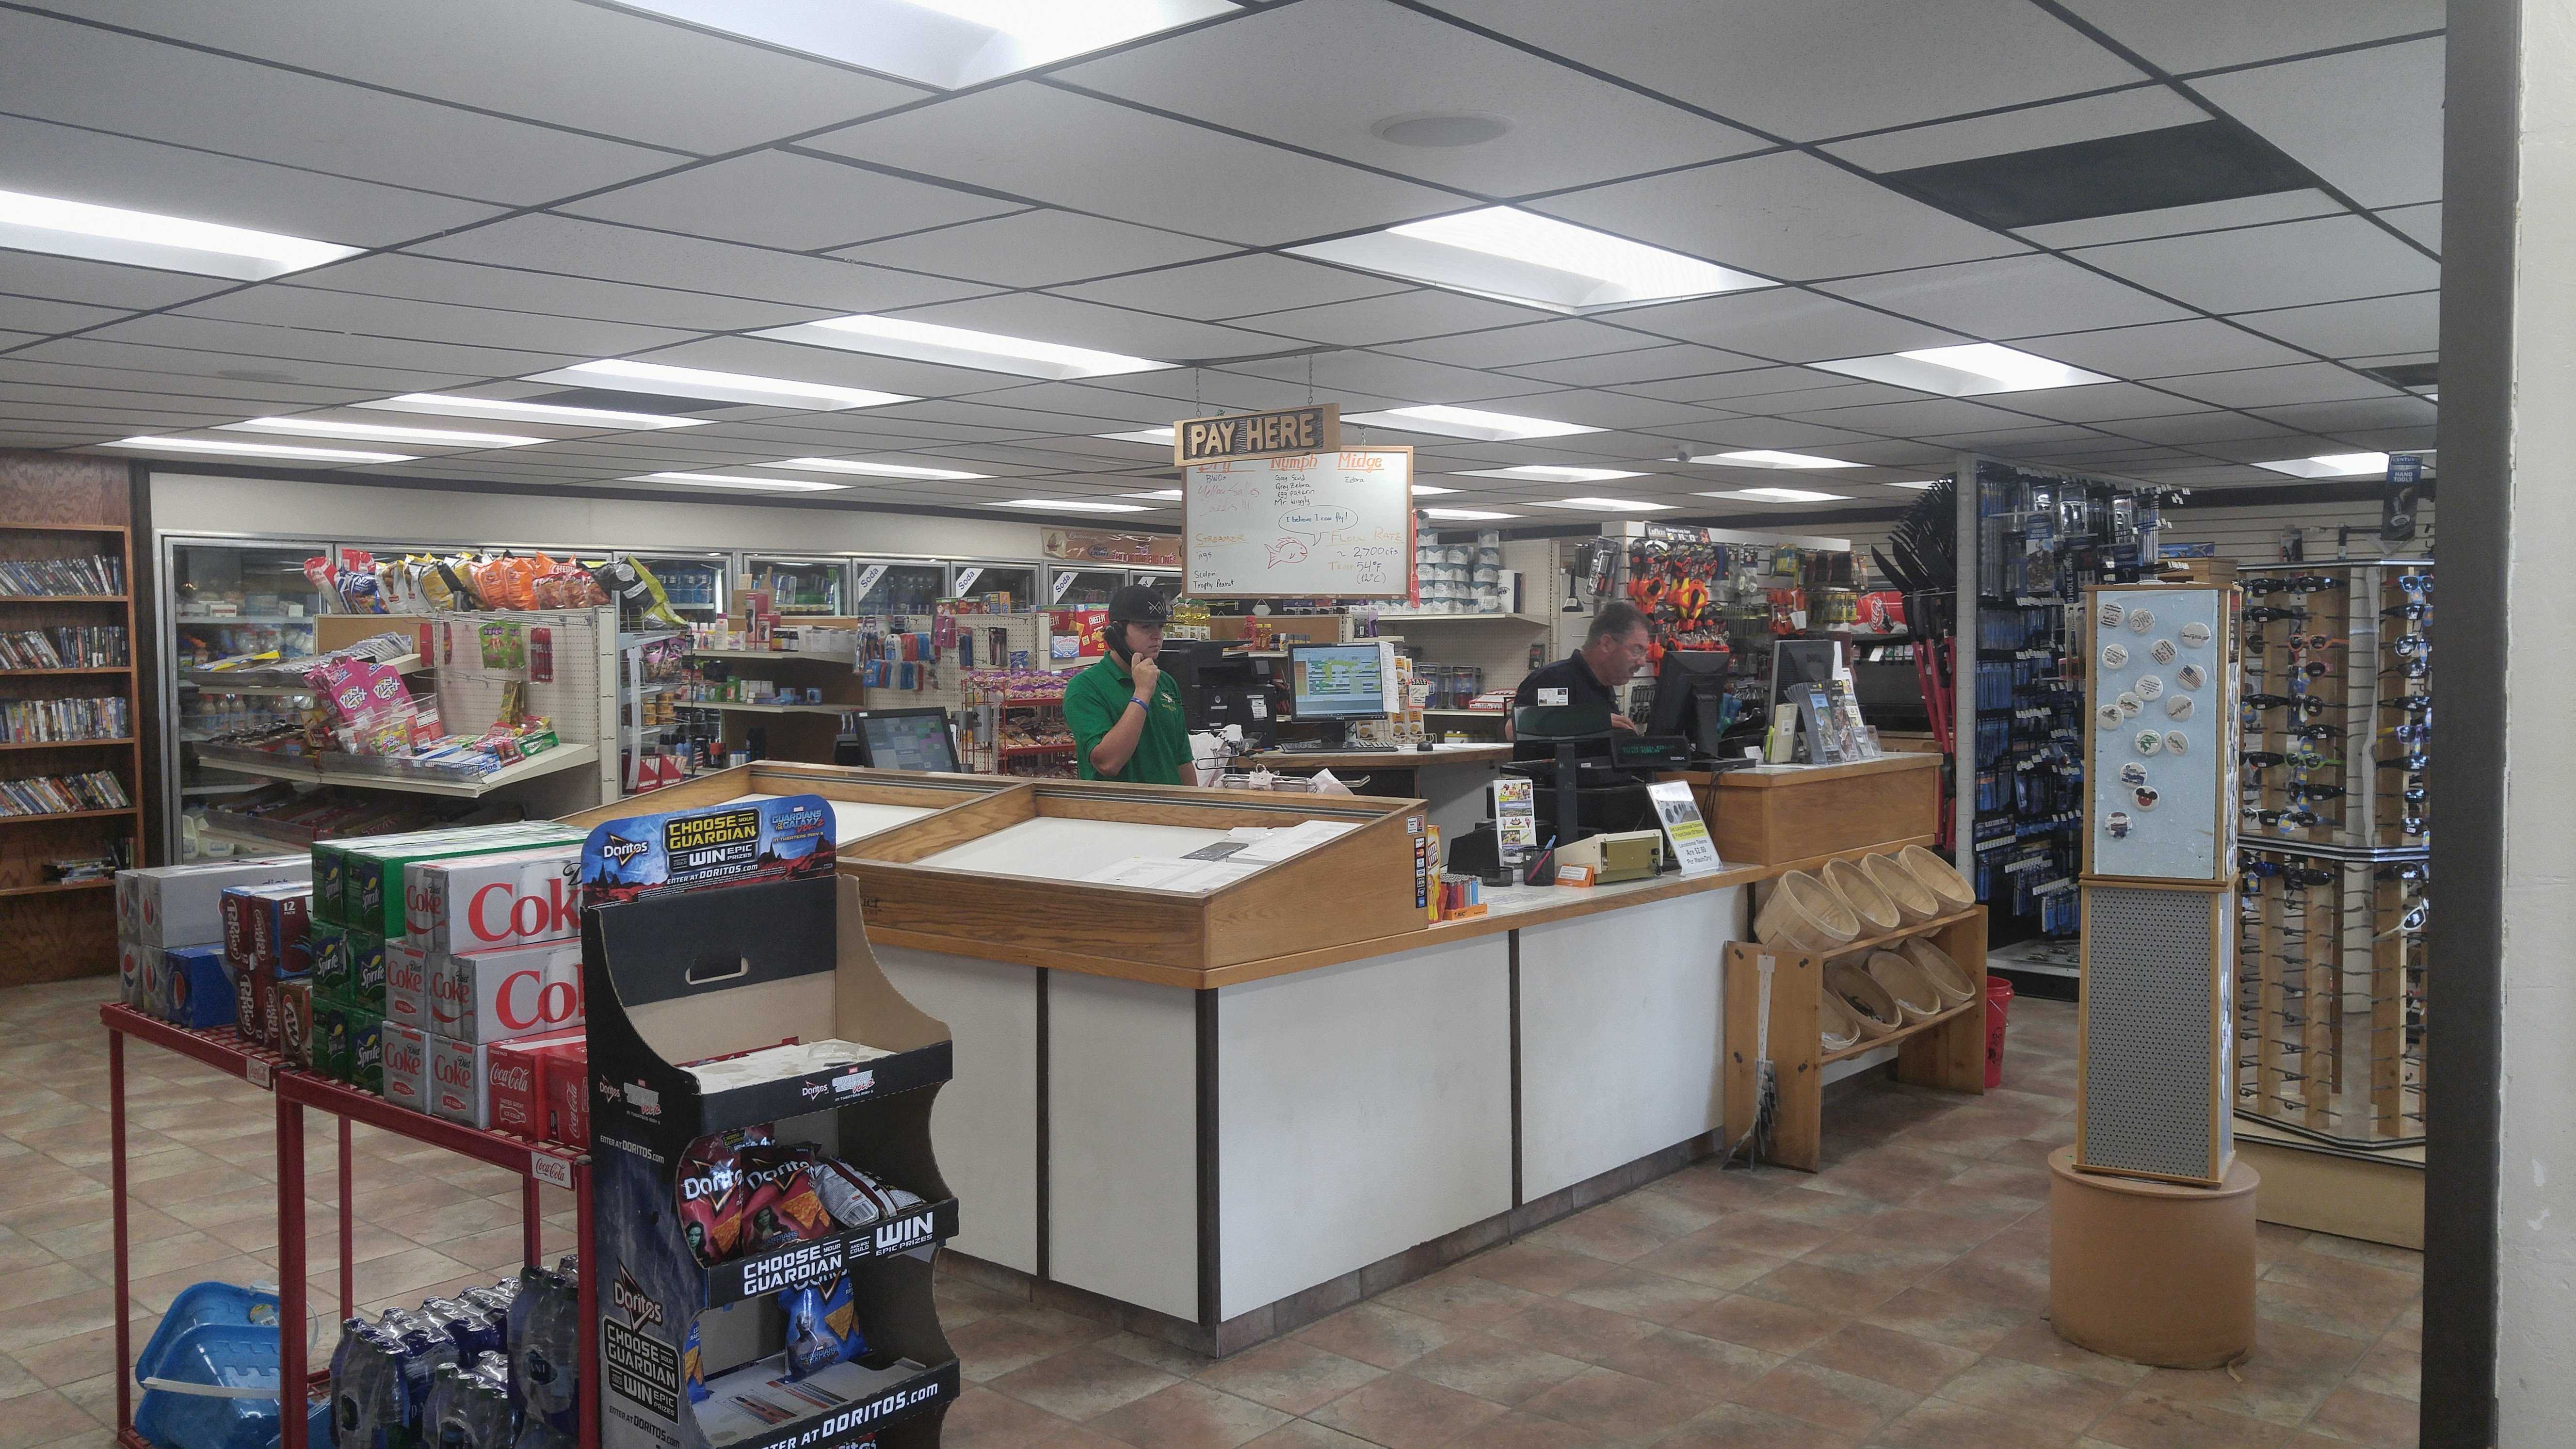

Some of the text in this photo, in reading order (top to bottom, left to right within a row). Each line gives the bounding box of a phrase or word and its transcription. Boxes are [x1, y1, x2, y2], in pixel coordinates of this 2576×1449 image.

[1191, 413, 1314, 455] PAY HERE
[1338, 452, 1382, 473] Midge
[860, 566, 879, 588] Soda
[958, 570, 975, 590] Soda
[1055, 574, 1071, 593] Soda
[1193, 581, 1213, 590] Trophy
[1194, 570, 1216, 579] Sculpin
[670, 815, 738, 837] CHOOSE
[772, 809, 822, 823] GUARDIANS
[783, 817, 819, 829] GALAXY
[604, 841, 648, 858] Doritos
[670, 825, 756, 850] GUARDIAN
[689, 844, 752, 867] WIN EPIC
[727, 852, 752, 861] PRIZES
[667, 877, 688, 885] ENTER
[699, 864, 758, 880] DORITOS.com
[283, 901, 296, 911] 12
[406, 885, 443, 915] Coke
[467, 879, 582, 942] Cok
[318, 950, 338, 977] Sprite
[361, 962, 385, 988] Sprite
[409, 960, 422, 972] Diet
[387, 961, 422, 992] Coke
[433, 972, 469, 1003] Coke
[455, 970, 469, 983] Diet
[239, 981, 252, 1028] Pepper
[495, 963, 586, 1030] Co
[357, 1046, 381, 1068] Sprite
[385, 1043, 420, 1075] Coke
[406, 1043, 420, 1055] Diet
[435, 1055, 471, 1089] Coke
[457, 1055, 471, 1068] Diet
[490, 1062, 531, 1092] Coca-Cola
[599, 1082, 621, 1097] Doritos
[802, 1083, 828, 1096] Doritos
[500, 1097, 524, 1109] TASTES GREAT
[566, 1079, 580, 1139] Coca-Cola
[600, 1135, 665, 1164] ENTER AT DORITOS.com
[535, 1157, 565, 1181] Coca-Cola
[683, 1168, 743, 1200] Dorito
[875, 1211, 934, 1249] WIN
[850, 1234, 934, 1256] COULD EPIC PRIZES
[743, 1245, 821, 1280] CHOOSE
[823, 1243, 841, 1253] YOUR
[743, 1254, 843, 1296] GUARDIAN
[614, 1281, 661, 1324] Doritos
[607, 1324, 674, 1365] CHOOSE YOUR
[608, 1342, 676, 1389] GUARDIAN
[624, 1374, 653, 1406] WIN
[653, 1390, 675, 1408] EPIC
[653, 1401, 675, 1417] PRIZES
[801, 1382, 939, 1446] AT DORITOS.com
[609, 1405, 680, 1449] ENTER AT DORITOS.com
